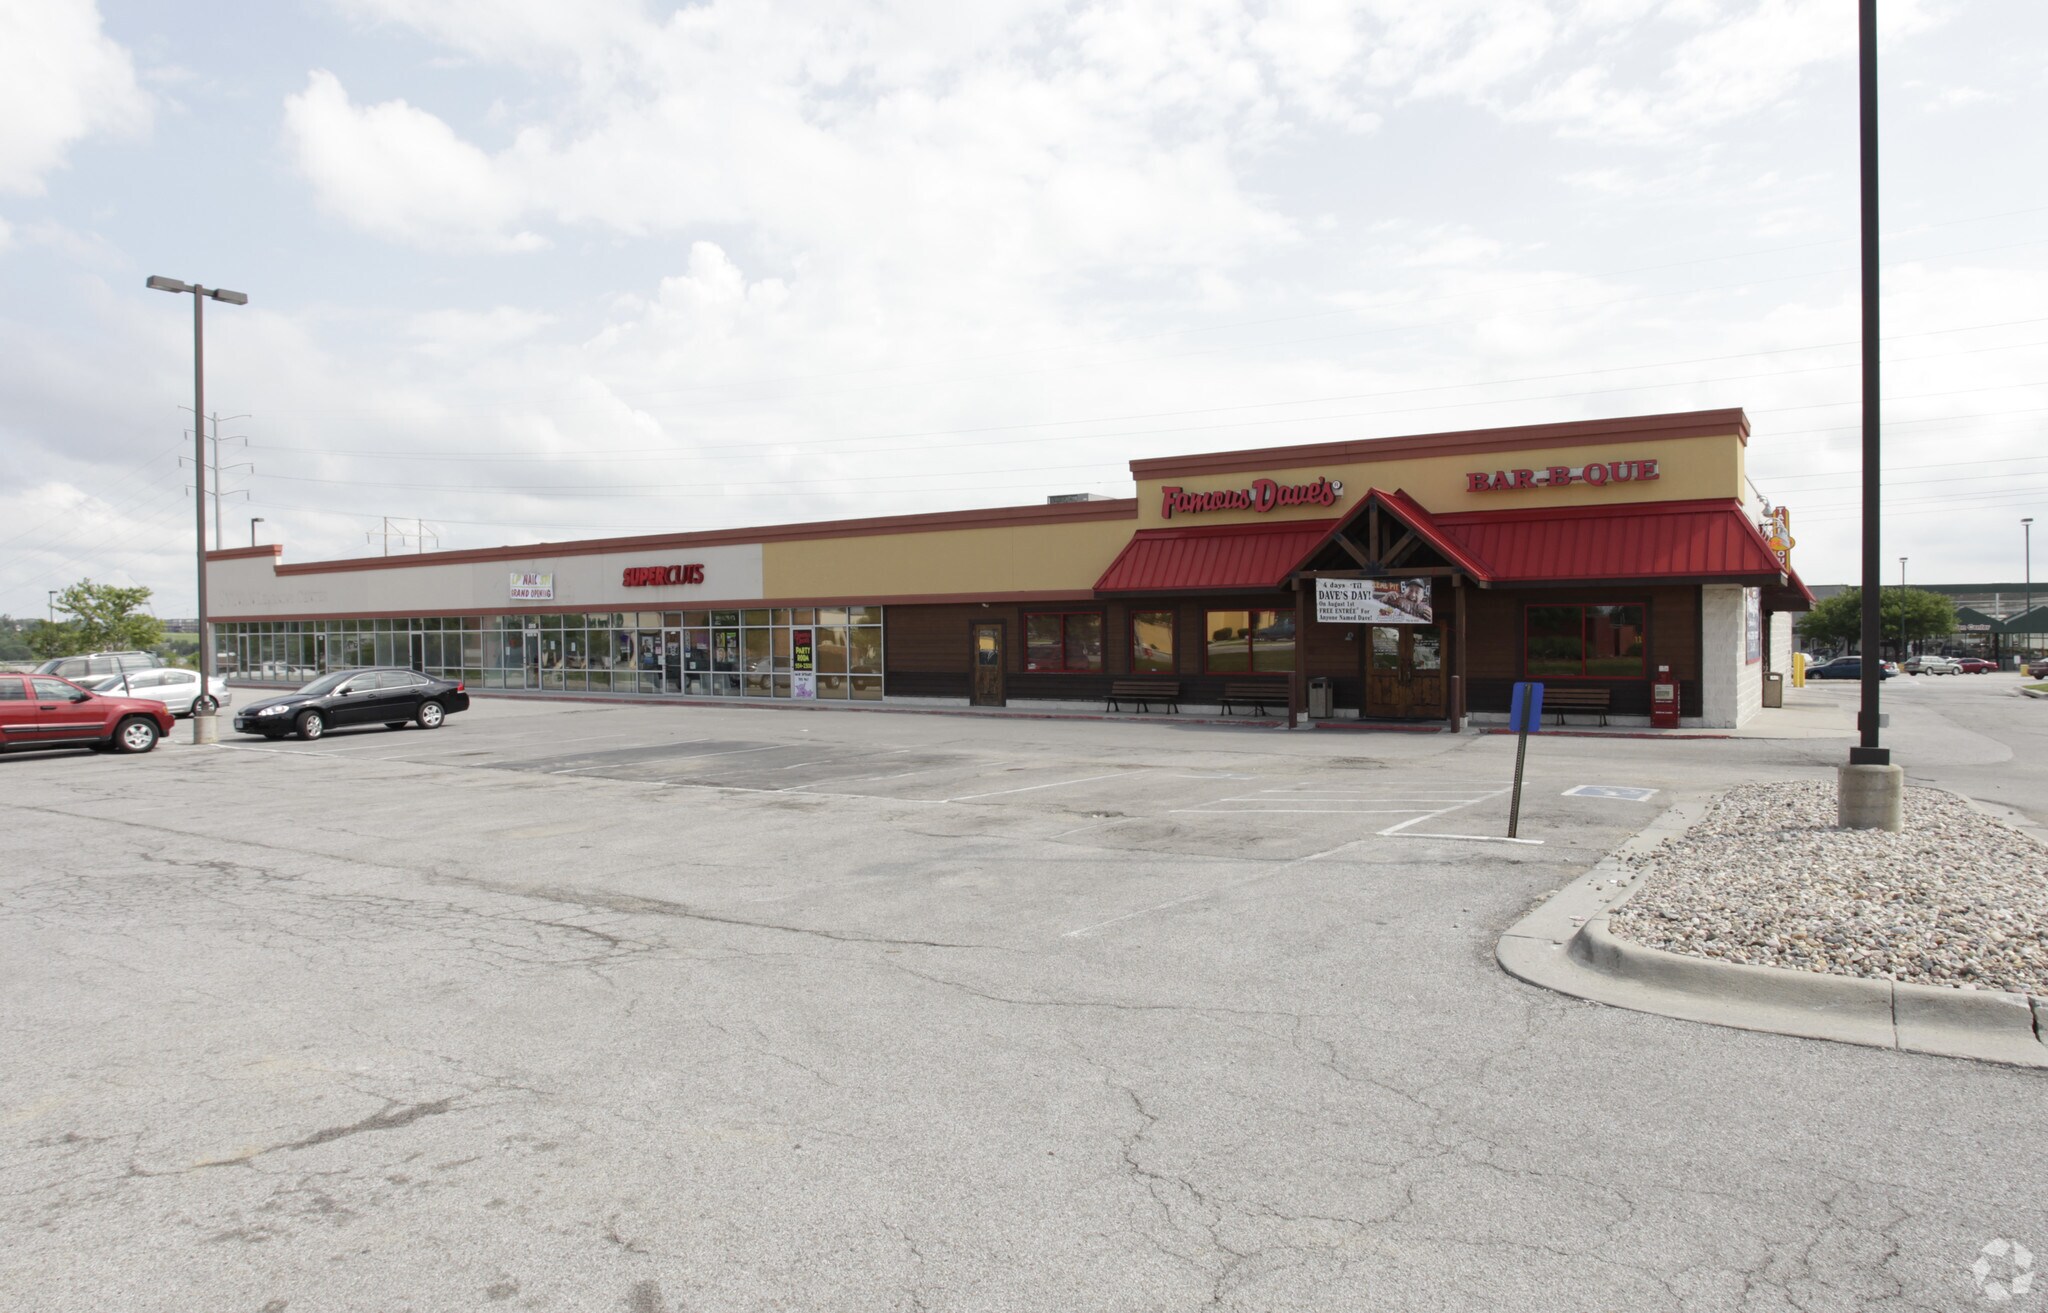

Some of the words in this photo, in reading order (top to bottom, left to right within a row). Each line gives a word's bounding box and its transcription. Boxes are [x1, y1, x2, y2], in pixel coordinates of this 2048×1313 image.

[1466, 458, 1660, 492] BAR-B-QUE
[1161, 485, 1252, 519] Famous
[622, 563, 705, 587] SUPERCUTS
[511, 588, 530, 597] GRAND
[530, 589, 552, 598] OPENING
[1319, 590, 1349, 600] DAVE'S
[1351, 590, 1372, 600] DAY!
